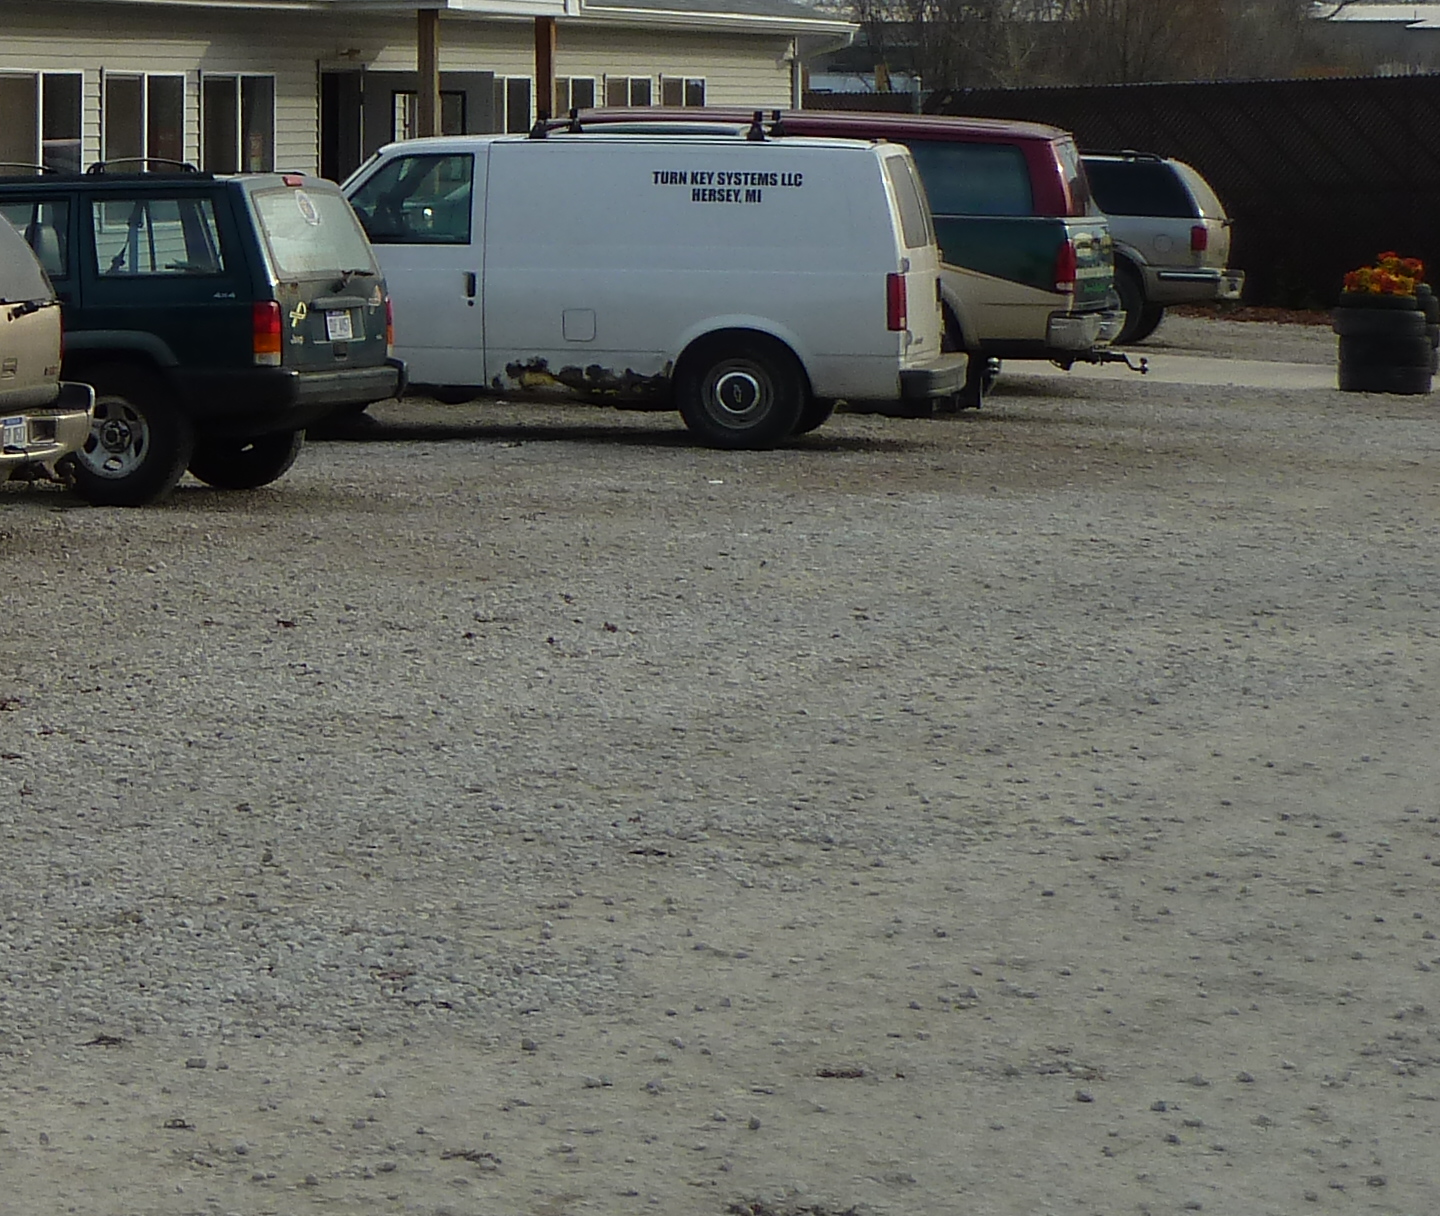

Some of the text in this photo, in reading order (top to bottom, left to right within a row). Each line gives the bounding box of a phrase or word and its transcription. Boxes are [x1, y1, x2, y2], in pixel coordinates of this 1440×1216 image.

[652, 170, 803, 187] TURN KEY SYSTEMS LLC
[691, 188, 762, 203] HERSEY, MI
